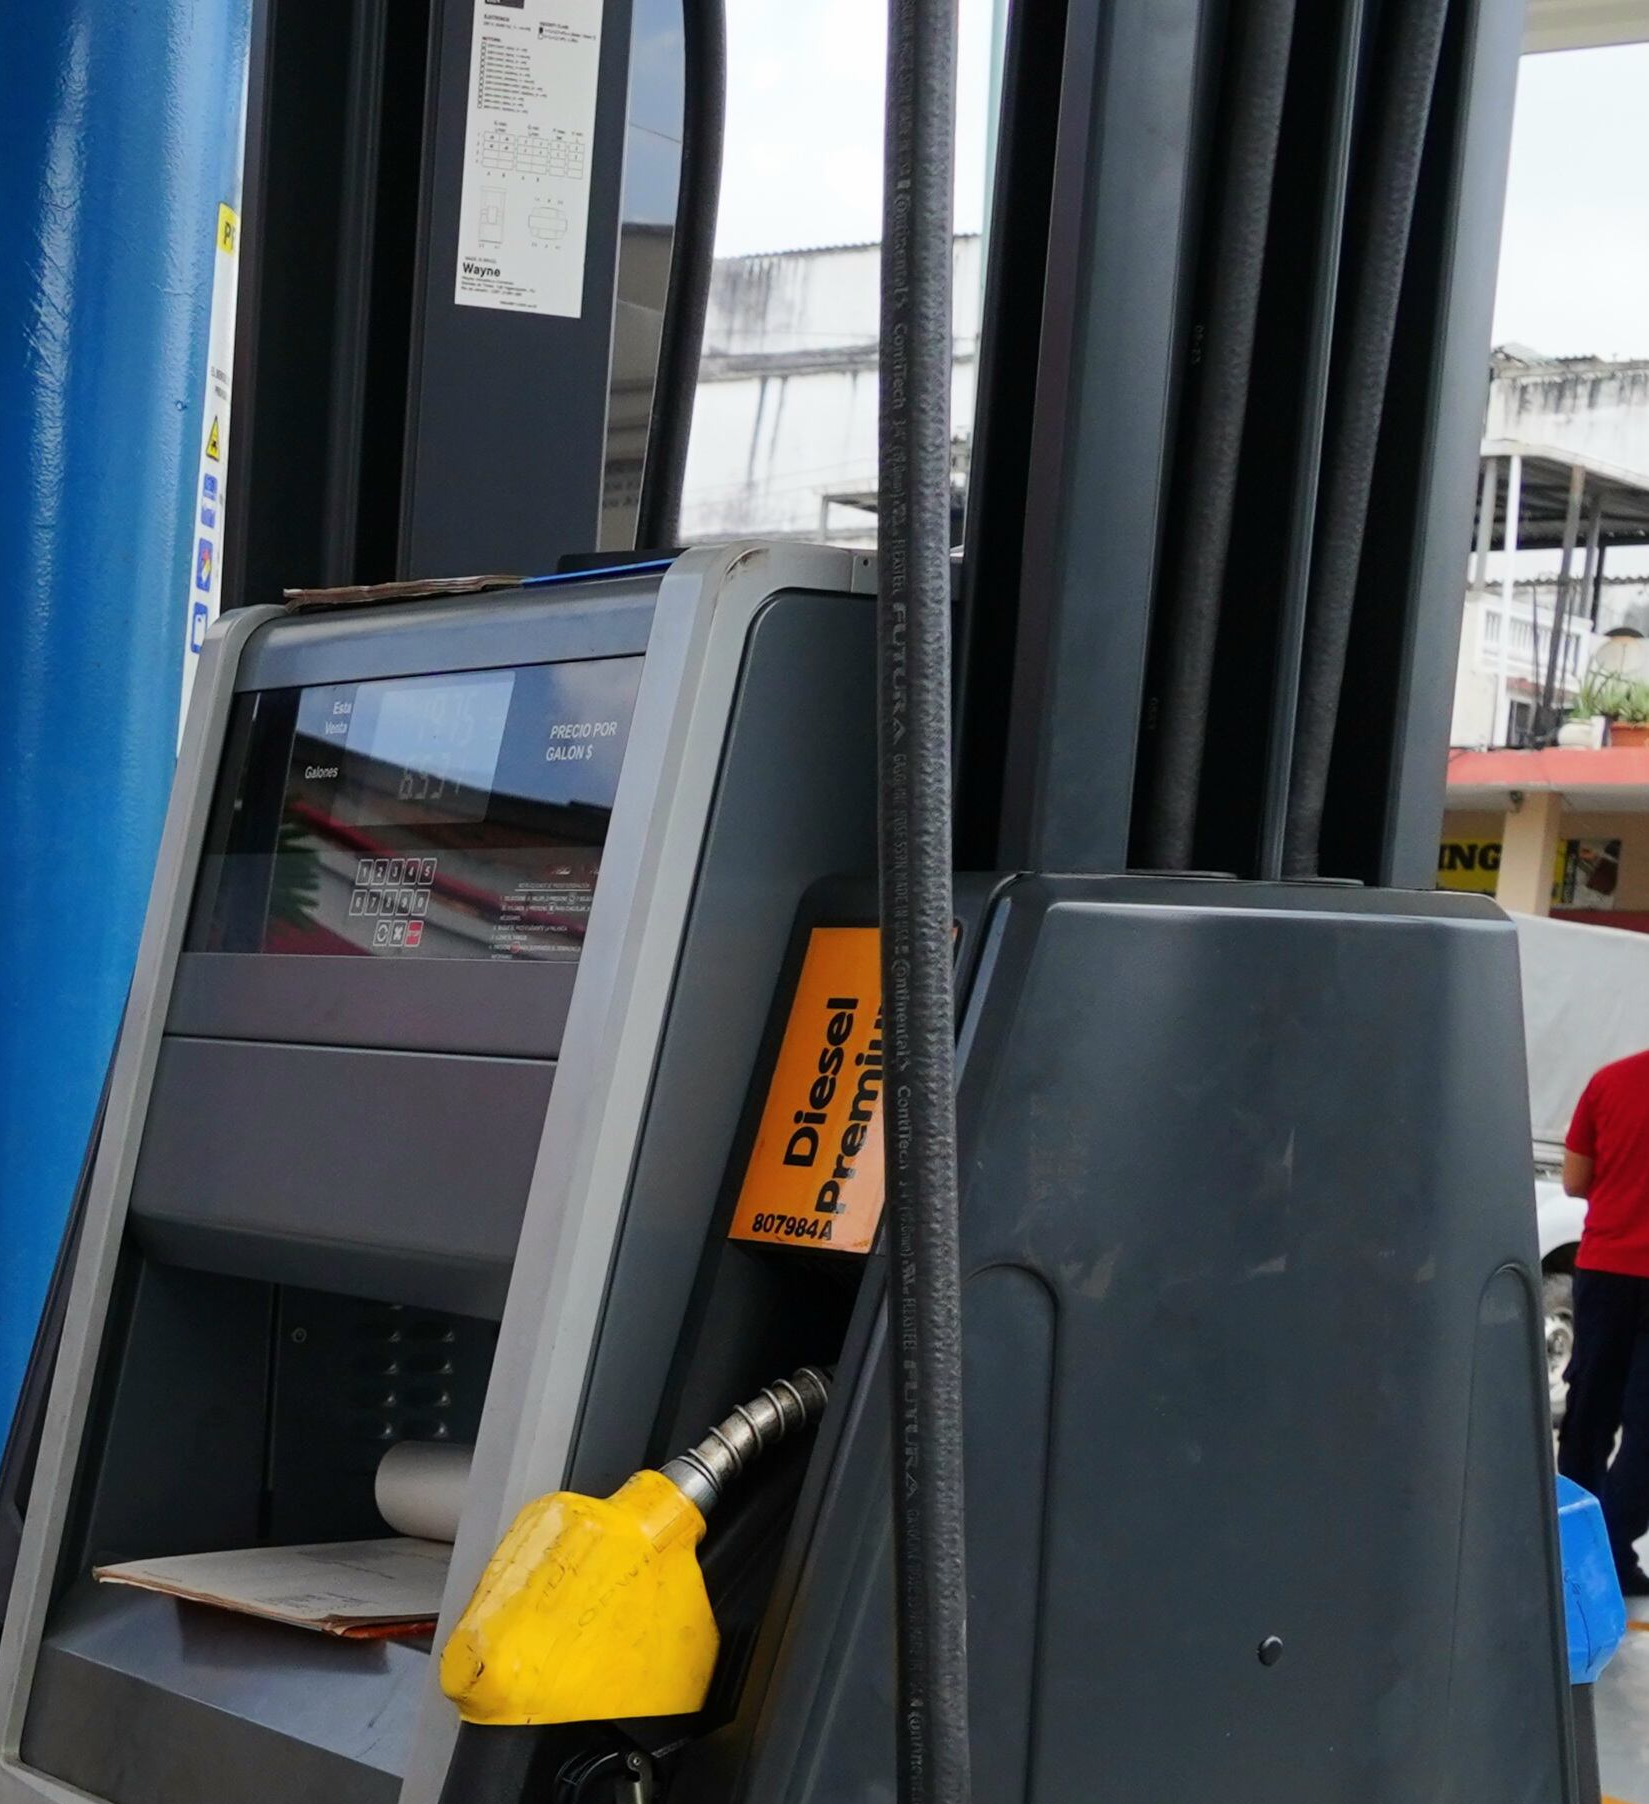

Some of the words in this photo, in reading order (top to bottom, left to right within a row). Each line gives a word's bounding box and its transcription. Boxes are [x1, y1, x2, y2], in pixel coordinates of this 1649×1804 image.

[463, 262, 501, 277] Wayne
[325, 721, 348, 734] Venta
[549, 723, 592, 739] PRECIO
[592, 721, 618, 737] POR
[546, 745, 585, 761] GALON
[585, 744, 594, 760] $
[304, 765, 339, 779] Galones
[892, 958, 911, 1056] Continental
[783, 998, 859, 1167] Diesel
[815, 1003, 883, 1213] Premi
[752, 1213, 832, 1241] 807984A
